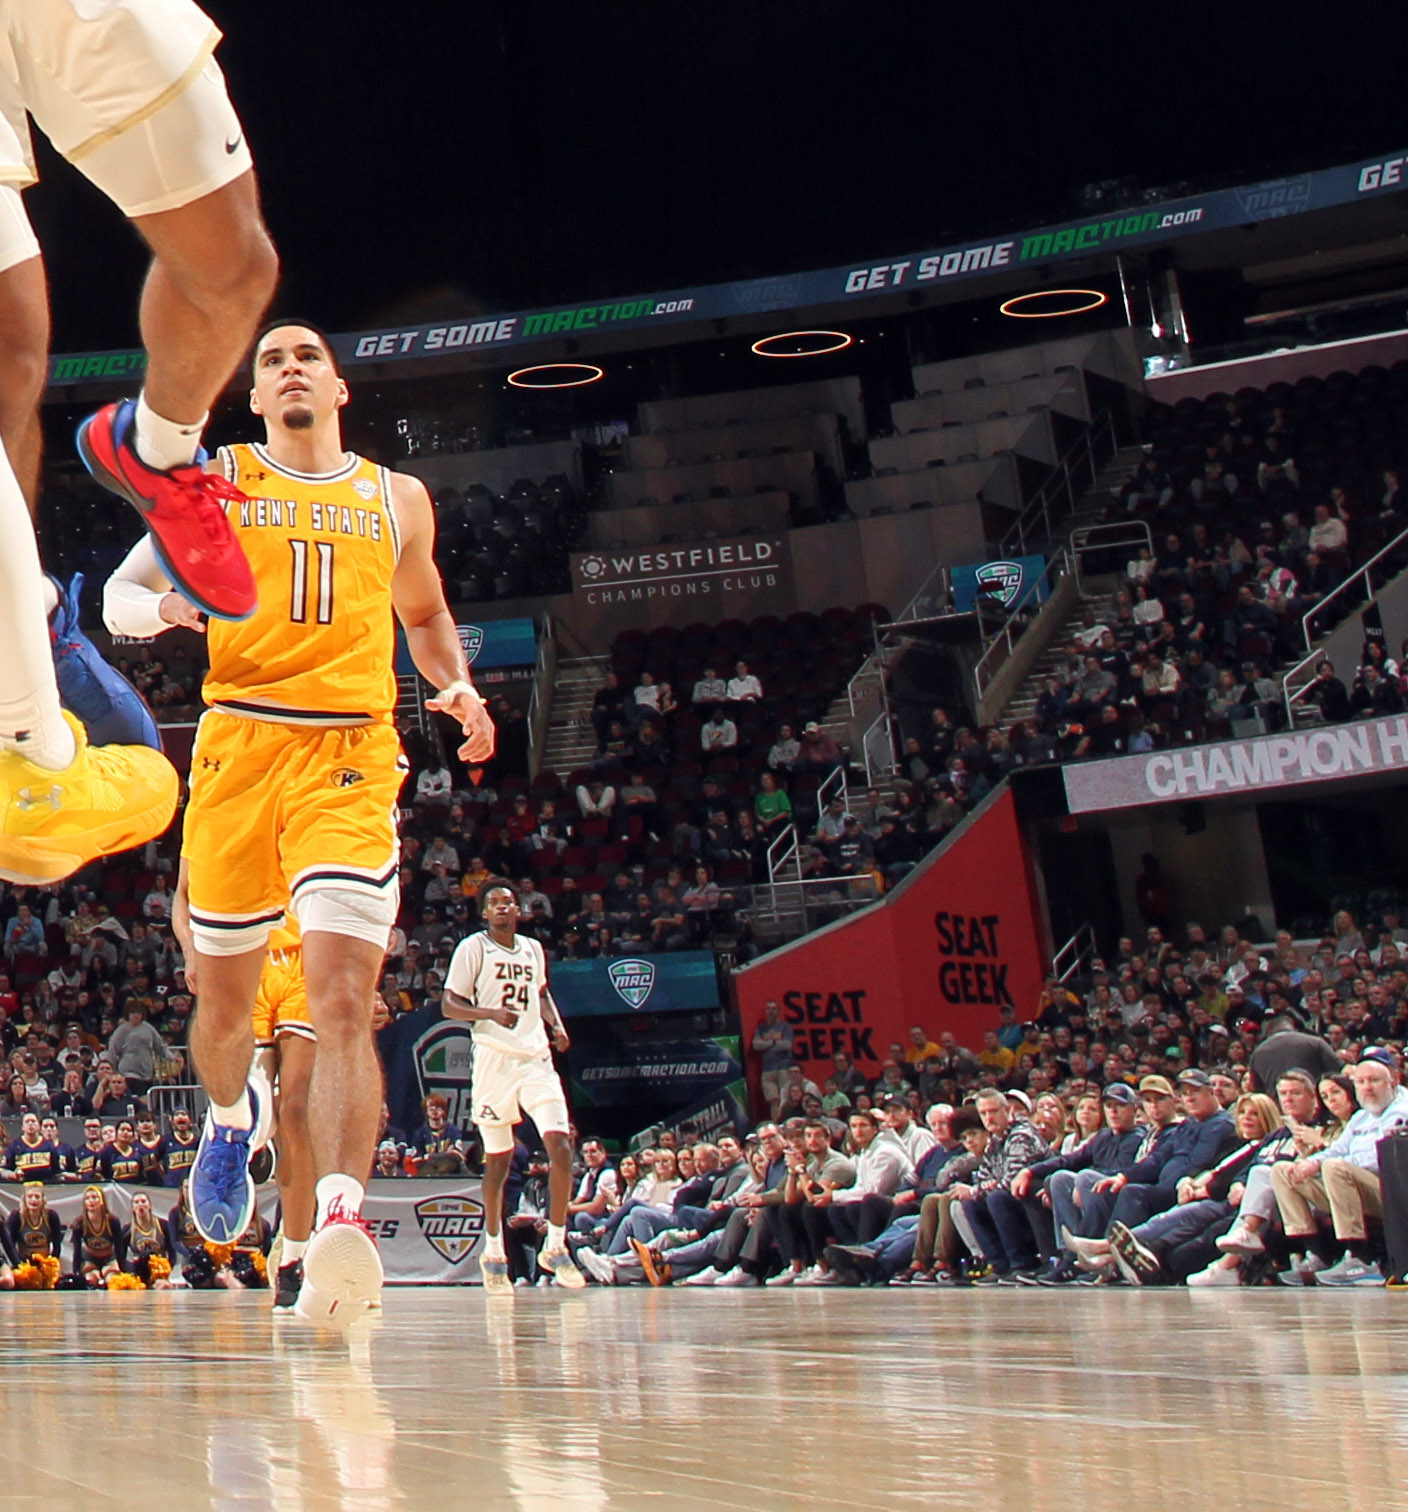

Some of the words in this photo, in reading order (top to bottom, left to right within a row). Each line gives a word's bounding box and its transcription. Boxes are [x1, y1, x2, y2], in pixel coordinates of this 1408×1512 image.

[1357, 156, 1408, 193] GE
[845, 261, 911, 293] GET
[916, 241, 1015, 281] SOME
[354, 331, 419, 358] GET
[424, 317, 517, 351] SOME
[240, 499, 298, 528] KENT
[311, 502, 382, 542] STATE
[611, 542, 772, 574] WESTFIELD
[288, 539, 334, 625] 11
[586, 580, 712, 605] CHAMPIONS
[722, 573, 777, 592] CLUB
[1145, 725, 1374, 797] CHAMPION
[935, 911, 999, 958] SEAT
[495, 962, 533, 982] ZIPS
[614, 975, 651, 986] MAC
[939, 961, 1016, 1009] GEEK
[502, 983, 529, 1011] 24
[783, 989, 867, 1025] SEAT
[792, 1028, 879, 1062] GEEK
[423, 1218, 482, 1234] MAC
